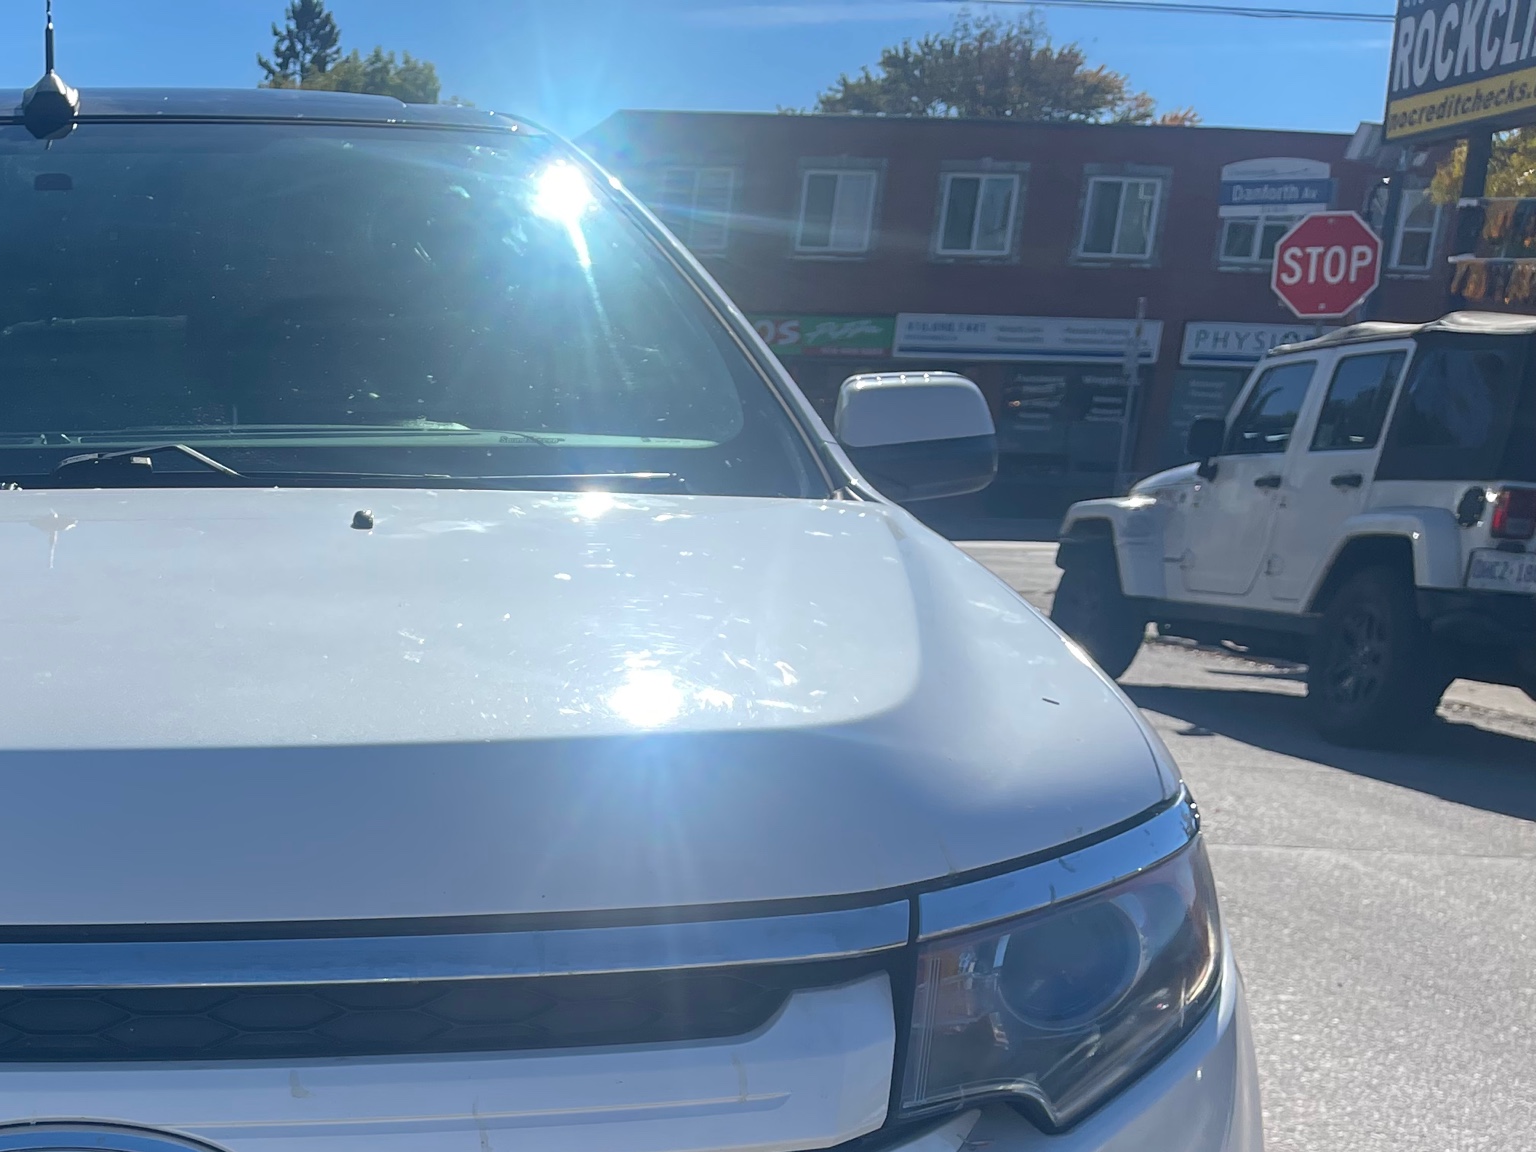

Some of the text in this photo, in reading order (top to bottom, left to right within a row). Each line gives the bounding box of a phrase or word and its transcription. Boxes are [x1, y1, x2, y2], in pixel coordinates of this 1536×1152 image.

[1392, 0, 1536, 92] ROCKCLI
[1389, 79, 1536, 131] nocreditchecks.
[1280, 244, 1373, 285] STOP
